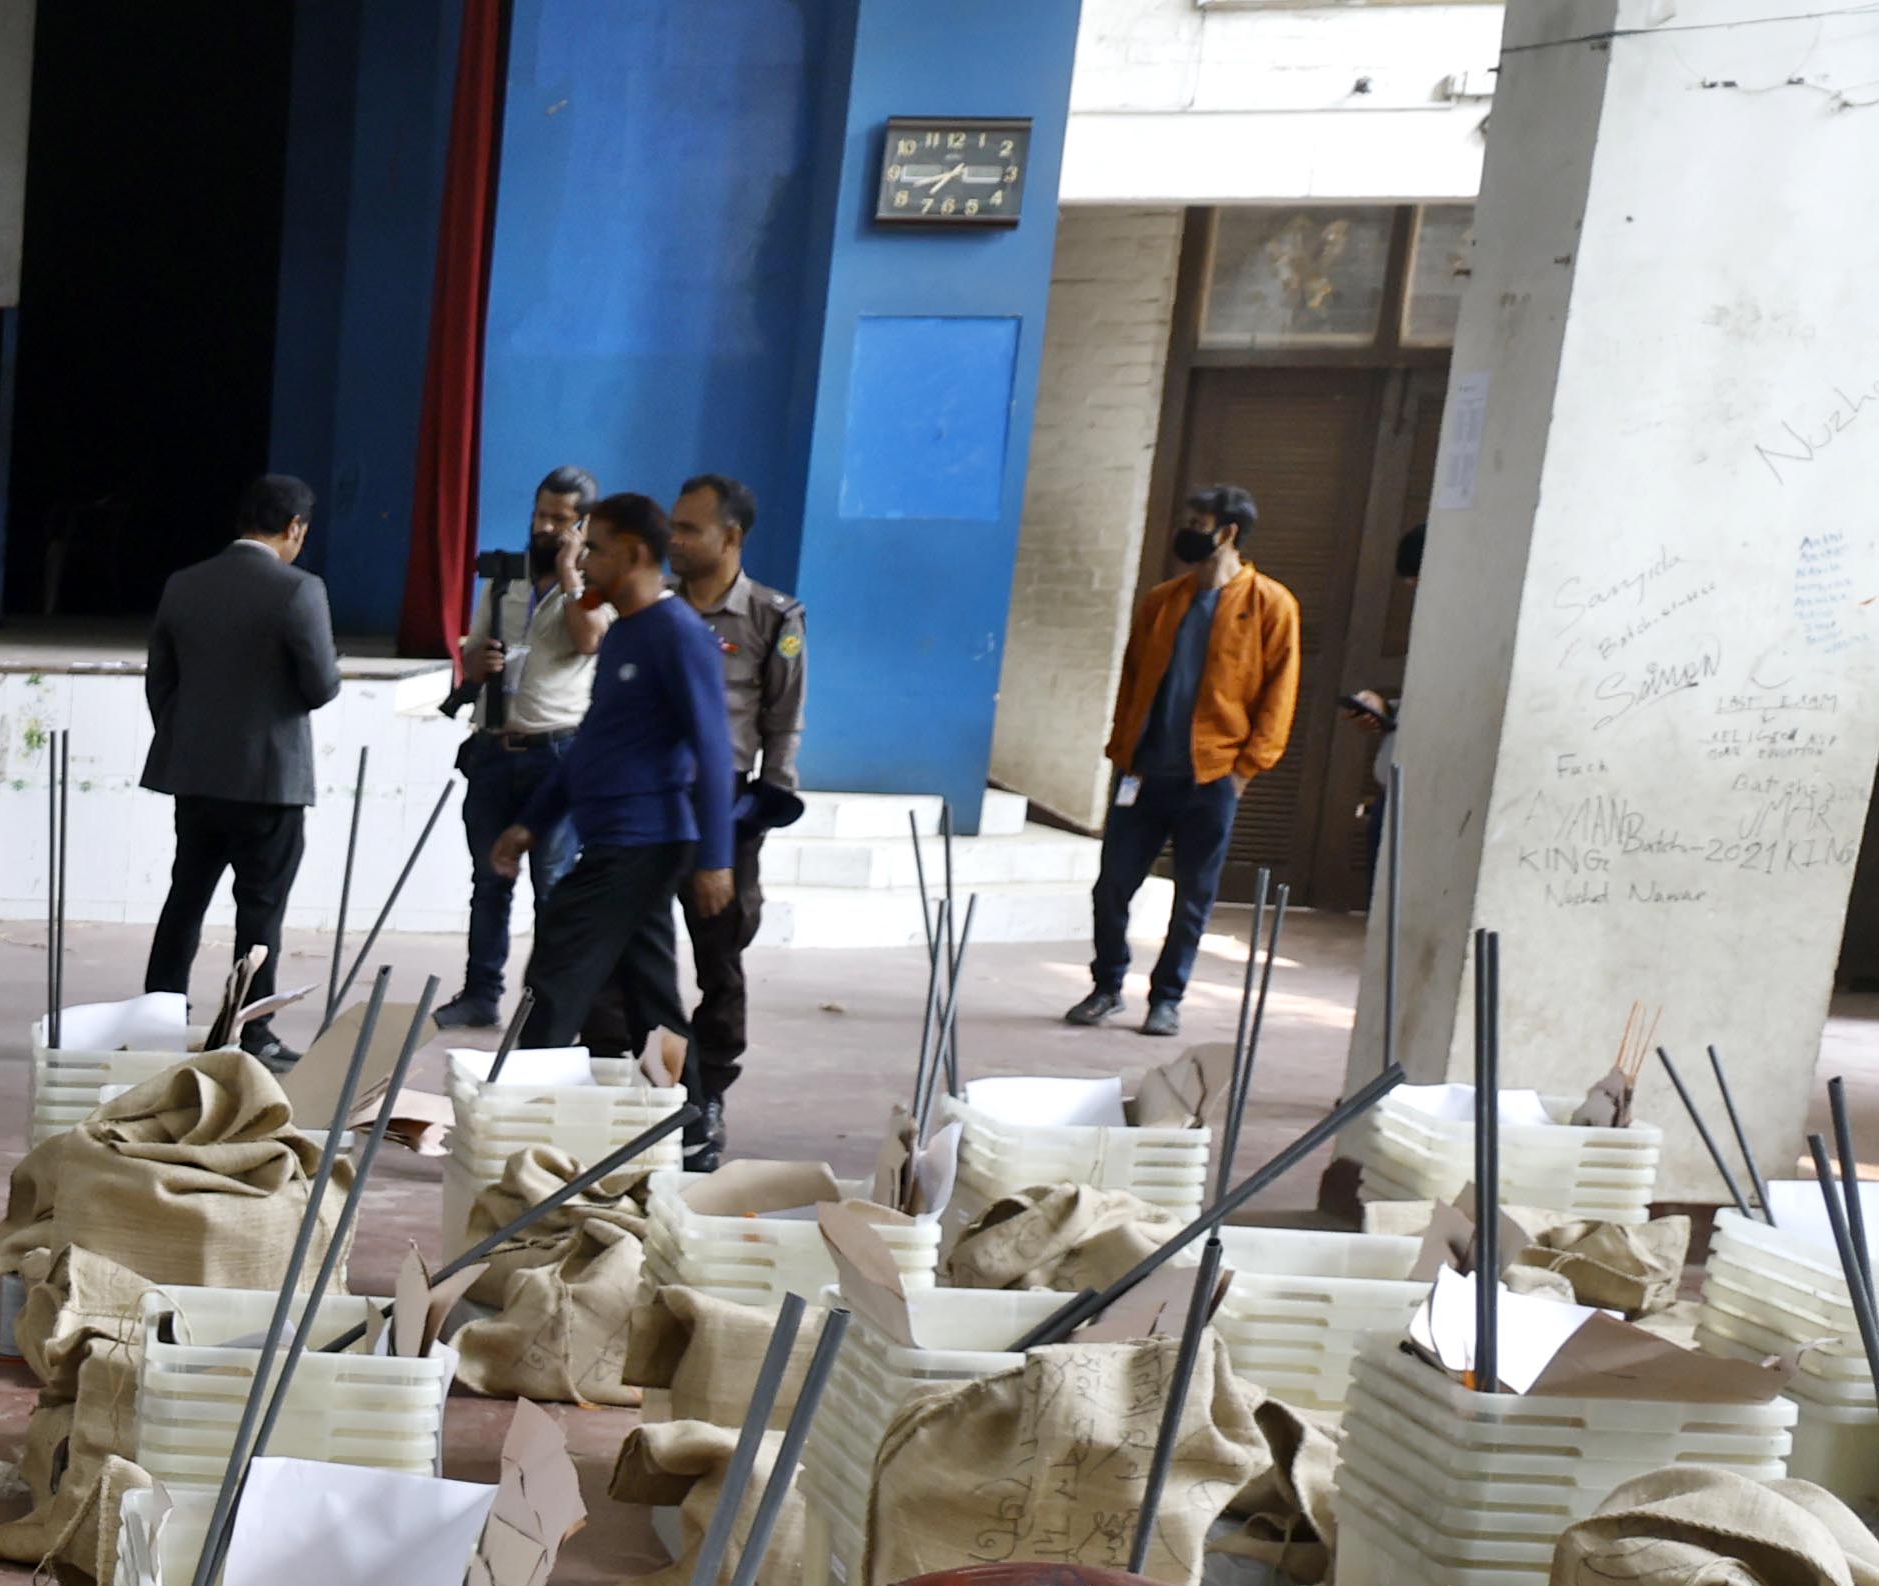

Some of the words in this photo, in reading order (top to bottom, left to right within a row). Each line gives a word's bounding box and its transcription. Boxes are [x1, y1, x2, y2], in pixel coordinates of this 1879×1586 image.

[897, 139, 917, 156] 10
[925, 132, 939, 148] 11
[947, 132, 966, 149] 12
[978, 132, 987, 148] 1
[999, 140, 1014, 157] 2
[887, 165, 901, 182] 9
[1003, 166, 1018, 183] 3
[893, 190, 909, 207] 8
[990, 189, 1003, 205] 4
[921, 198, 934, 215] 7
[940, 197, 956, 215] 6
[964, 198, 979, 216] 5
